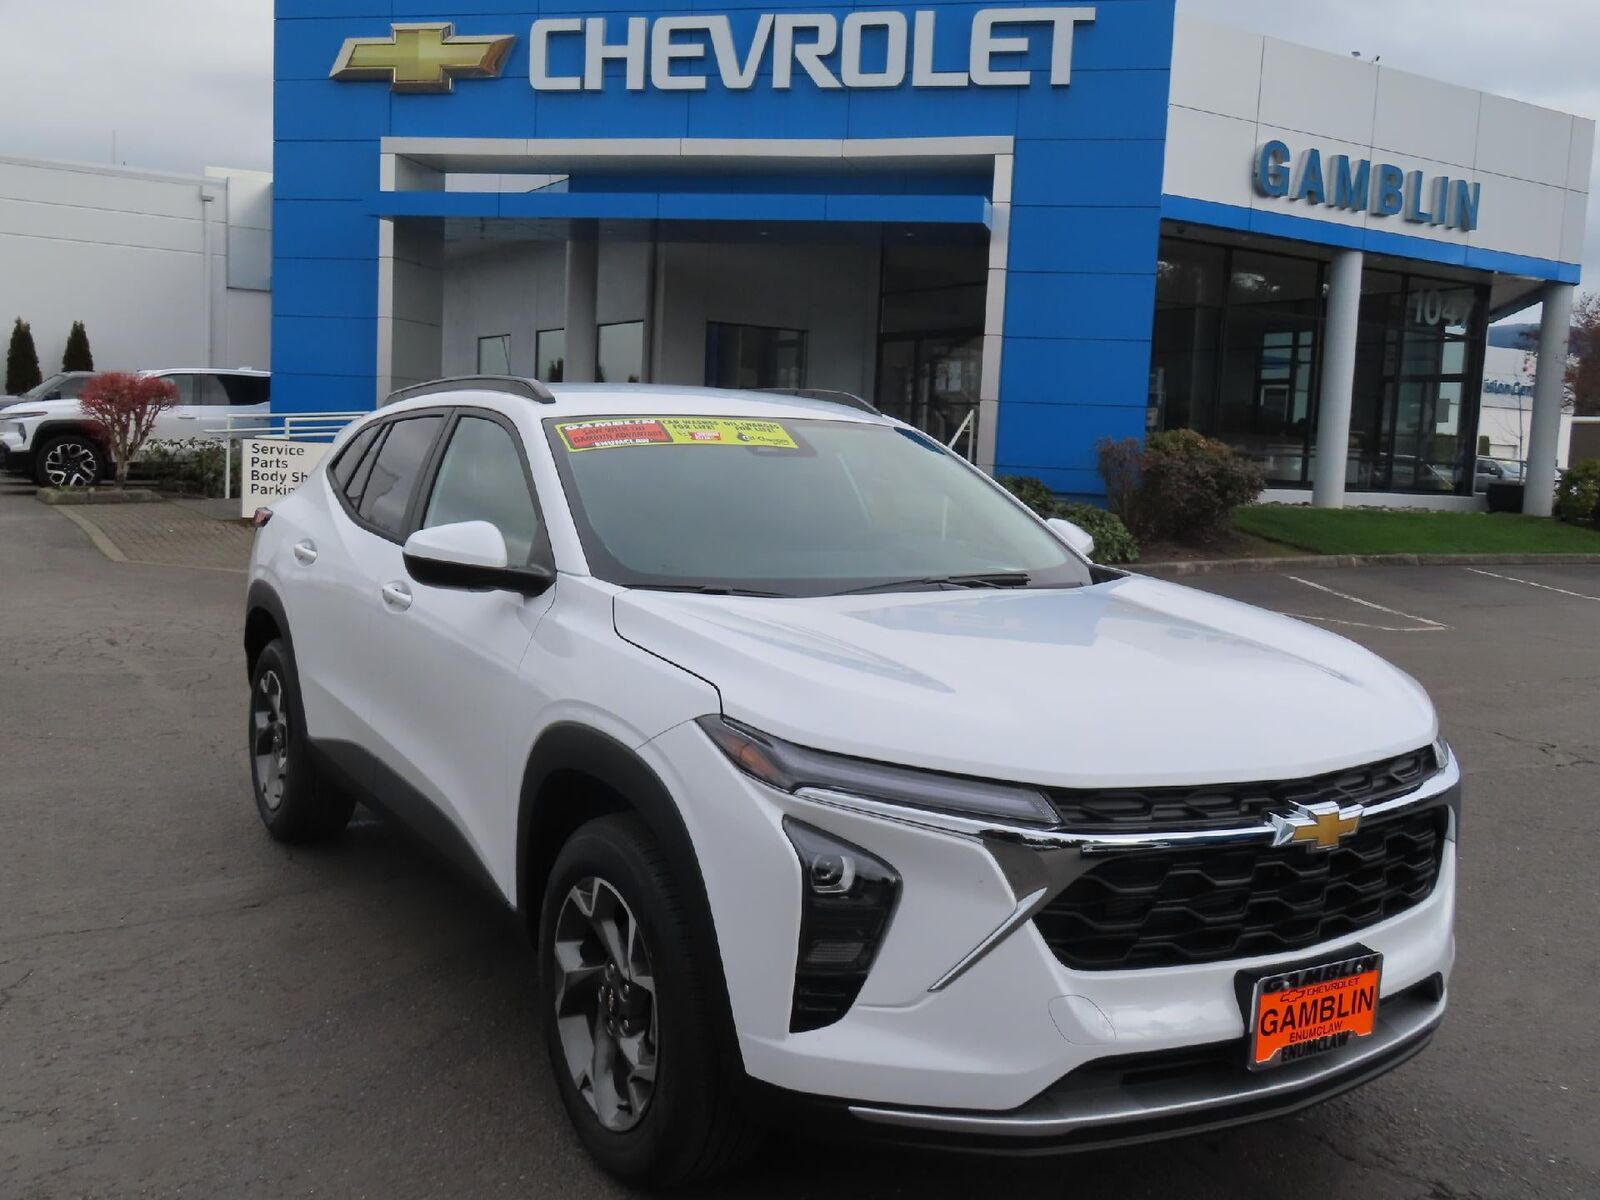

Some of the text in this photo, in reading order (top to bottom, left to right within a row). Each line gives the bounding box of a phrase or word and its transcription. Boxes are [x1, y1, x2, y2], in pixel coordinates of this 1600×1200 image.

[528, 7, 1096, 92] CHEVROLET
[1254, 140, 1480, 231] GAMBLIN
[564, 419, 656, 430] GAMBLIN
[251, 443, 304, 456] Service
[251, 457, 288, 469] Parts
[251, 470, 308, 484] Body Sh
[251, 484, 296, 496] Parkin
[1307, 977, 1360, 996] CHEVROLET
[1260, 986, 1374, 1037] GAMBLIN
[1289, 1021, 1343, 1043] ENUMCLAW
[1281, 1031, 1350, 1062] ENUMCLAW
